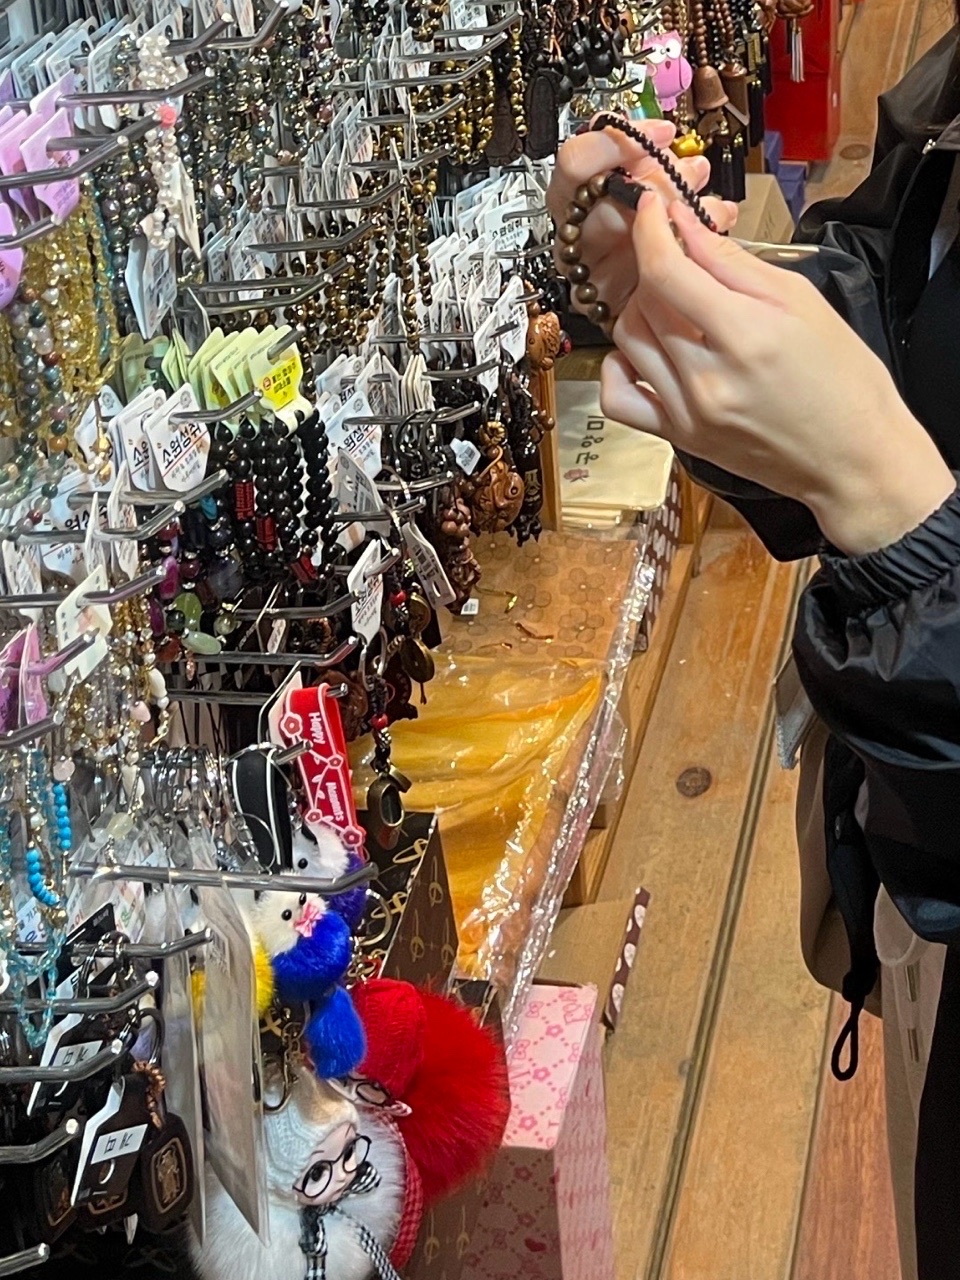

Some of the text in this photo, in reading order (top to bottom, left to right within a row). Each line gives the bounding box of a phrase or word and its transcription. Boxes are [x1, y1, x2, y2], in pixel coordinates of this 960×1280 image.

[163, 421, 202, 470] 소원성취
[575, 414, 607, 466] 공양미
[308, 712, 326, 745] Happy
